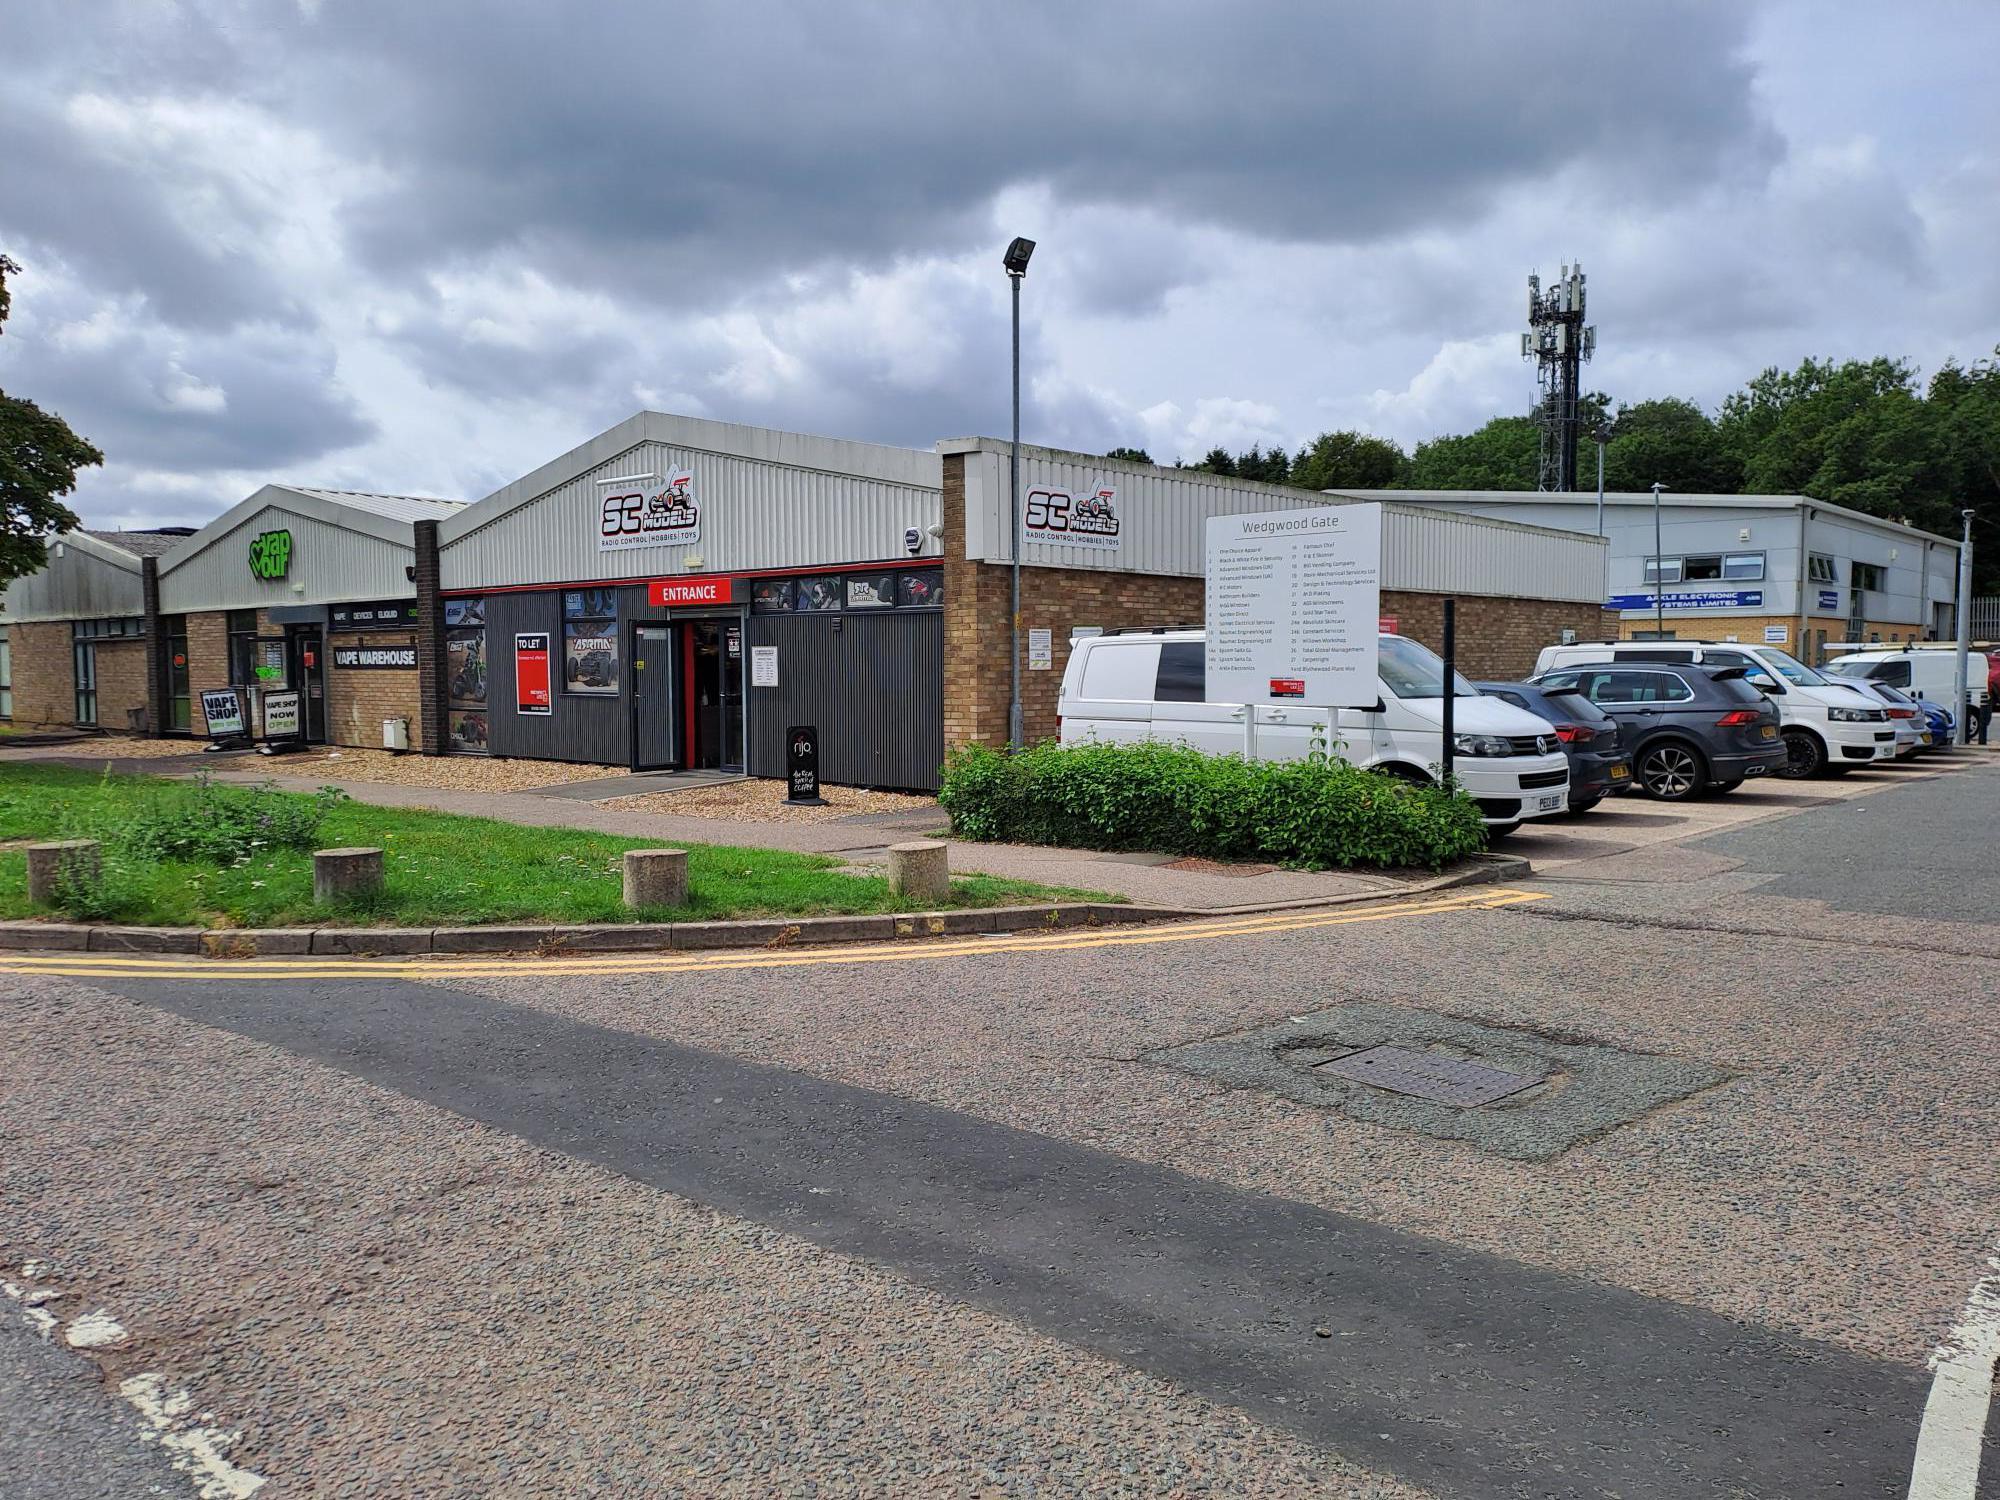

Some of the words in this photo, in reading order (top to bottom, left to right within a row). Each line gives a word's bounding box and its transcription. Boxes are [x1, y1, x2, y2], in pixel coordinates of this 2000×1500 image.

[602, 493, 643, 536] SC
[1026, 490, 1070, 532] SC
[642, 507, 697, 532] MODELS
[1070, 514, 1119, 536] MODELS
[1242, 518, 1307, 534] Wedgwood
[1312, 516, 1338, 528] Gate
[621, 536, 647, 544] CONTROL
[651, 534, 678, 542] HOBBIES
[1047, 534, 1074, 542] CONTROL
[663, 586, 716, 601] ENTRANCE
[378, 610, 398, 618] ELIQUID
[518, 640, 527, 648] TO
[528, 639, 539, 648] LET
[336, 652, 358, 665] VAPE
[359, 651, 415, 665] WAREHOUSE
[206, 696, 236, 709] VAPE
[208, 708, 238, 720] SHOP
[270, 711, 294, 719] NOW
[268, 720, 296, 728] OPEN
